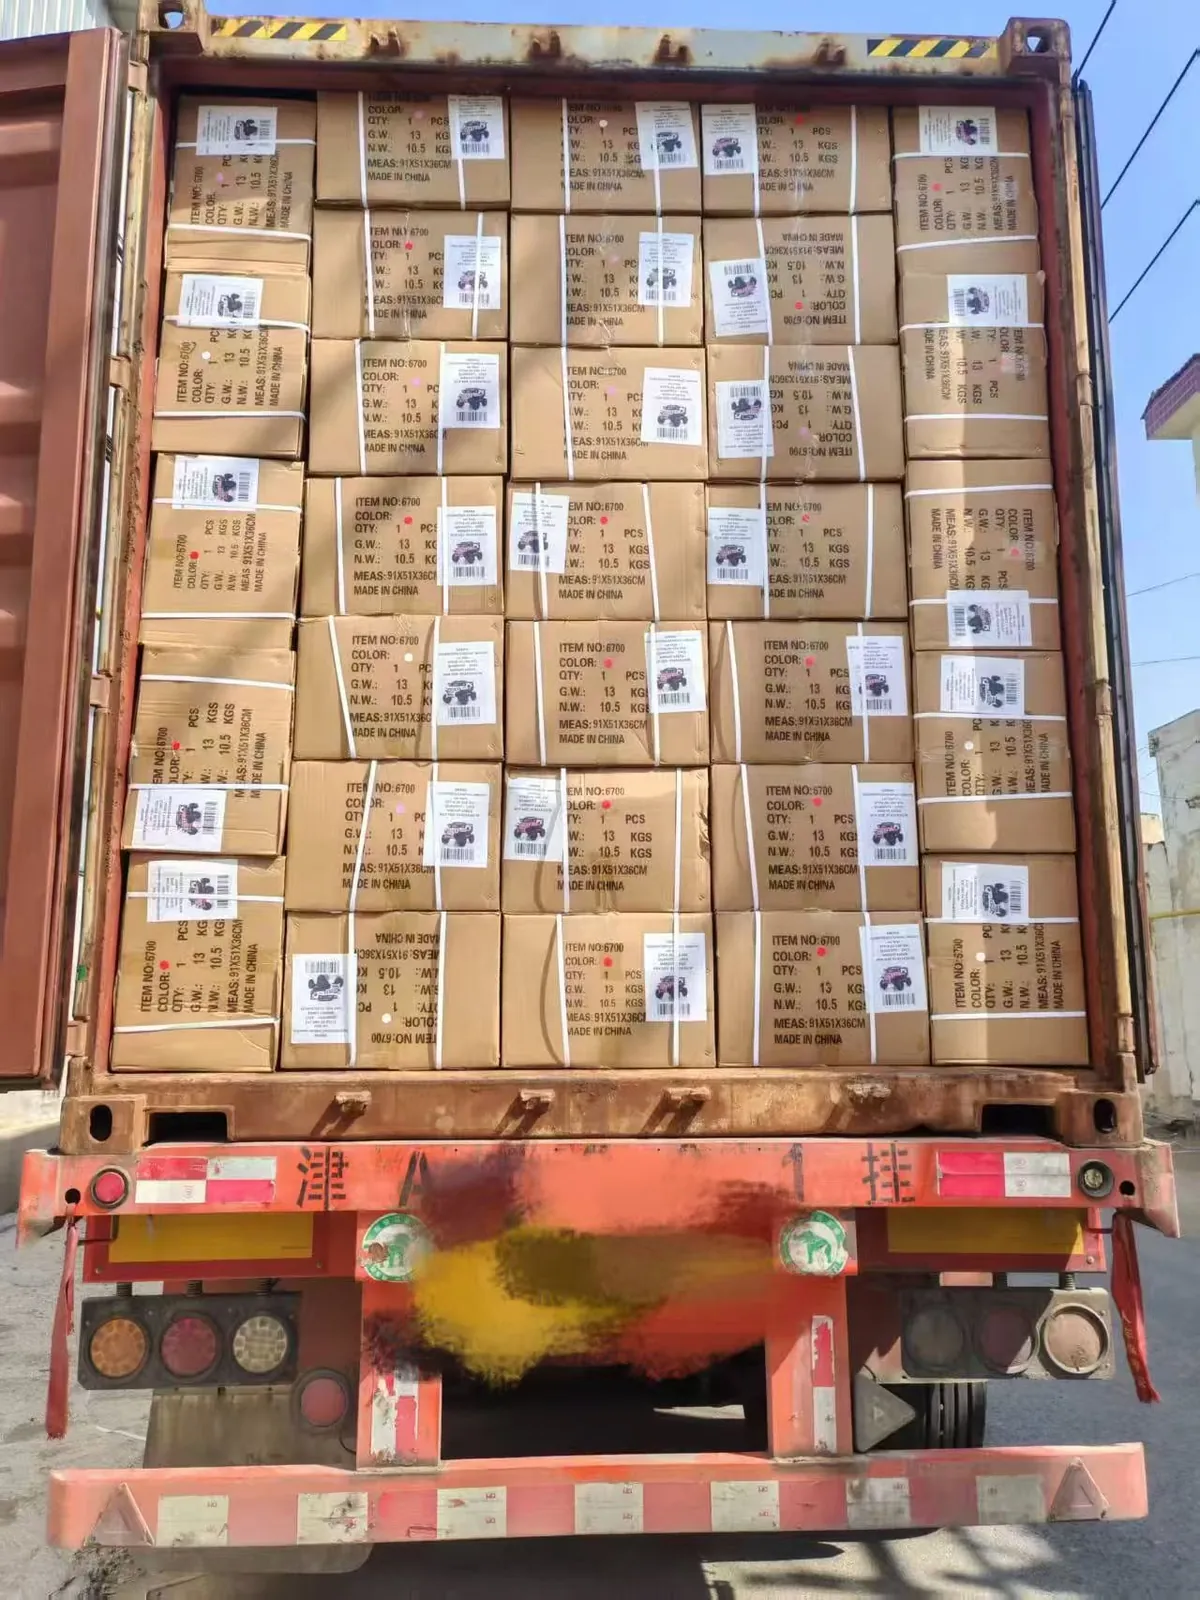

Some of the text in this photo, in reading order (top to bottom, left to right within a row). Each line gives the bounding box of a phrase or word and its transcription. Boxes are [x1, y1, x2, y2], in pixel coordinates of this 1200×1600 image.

[224, 353, 234, 362] 13
[363, 359, 386, 367] ITEM
[270, 347, 283, 406] MADE IN CHINA
[177, 380, 188, 402] ITEM
[406, 399, 416, 408] 13
[402, 412, 421, 423] 10.5
[388, 444, 425, 452] IN CHINA
[356, 498, 380, 507] ITEM
[624, 529, 643, 538] PCS
[399, 539, 410, 549] 13
[603, 544, 649, 554] 13 KGS
[395, 554, 414, 564] 10.5
[598, 559, 649, 569] 10.5 KGS
[354, 586, 418, 595] MADE IN CHINA
[559, 590, 623, 599] MADE IN CHINA
[352, 636, 377, 645] ITEM
[764, 641, 788, 650] ITEM
[560, 643, 584, 652] ITEM
[625, 671, 645, 681] PCS
[830, 668, 849, 677] PCS
[396, 679, 408, 690] 13
[810, 684, 820, 694] 13
[605, 686, 615, 697] 13
[391, 695, 412, 705] 10.5
[805, 699, 825, 709] 10.5
[600, 702, 620, 712] 10.5
[378, 728, 416, 737] IN CHINA
[765, 731, 830, 741] MADE IN CHINA
[559, 734, 624, 744] MADE IN CHINA
[766, 786, 790, 795] ITEM
[626, 815, 645, 824] PCS
[834, 815, 853, 824] PCS
[603, 830, 652, 842] 13 KGS
[813, 830, 824, 841] 13
[599, 847, 652, 858] 10.5 KGS
[809, 846, 830, 857] 10.5
[586, 881, 624, 891] IN CHINA
[769, 880, 835, 890] MADE IN CHINA
[178, 921, 188, 941] PCS
[772, 936, 798, 945] ITEM
[565, 943, 585, 952] ITEM
[194, 953, 205, 964] 13
[210, 948, 222, 969] 10.5
[1000, 950, 1011, 961] 13
[1016, 945, 1028, 966] 10.5
[625, 971, 641, 979] PCS
[842, 966, 862, 975] PCS
[1052, 940, 1064, 1009] MADE IN CHINA
[244, 944, 257, 1013] MADE IN CHINA
[625, 985, 643, 993] KGS
[820, 982, 832, 993] 13
[141, 986, 152, 1012] ITEM
[955, 982, 966, 1008] ITEM
[625, 999, 643, 1008] KGS
[816, 999, 837, 1010] 10.5
[774, 1034, 842, 1044] MADE IN CHINA
[296, 1146, 349, 1211] 津
